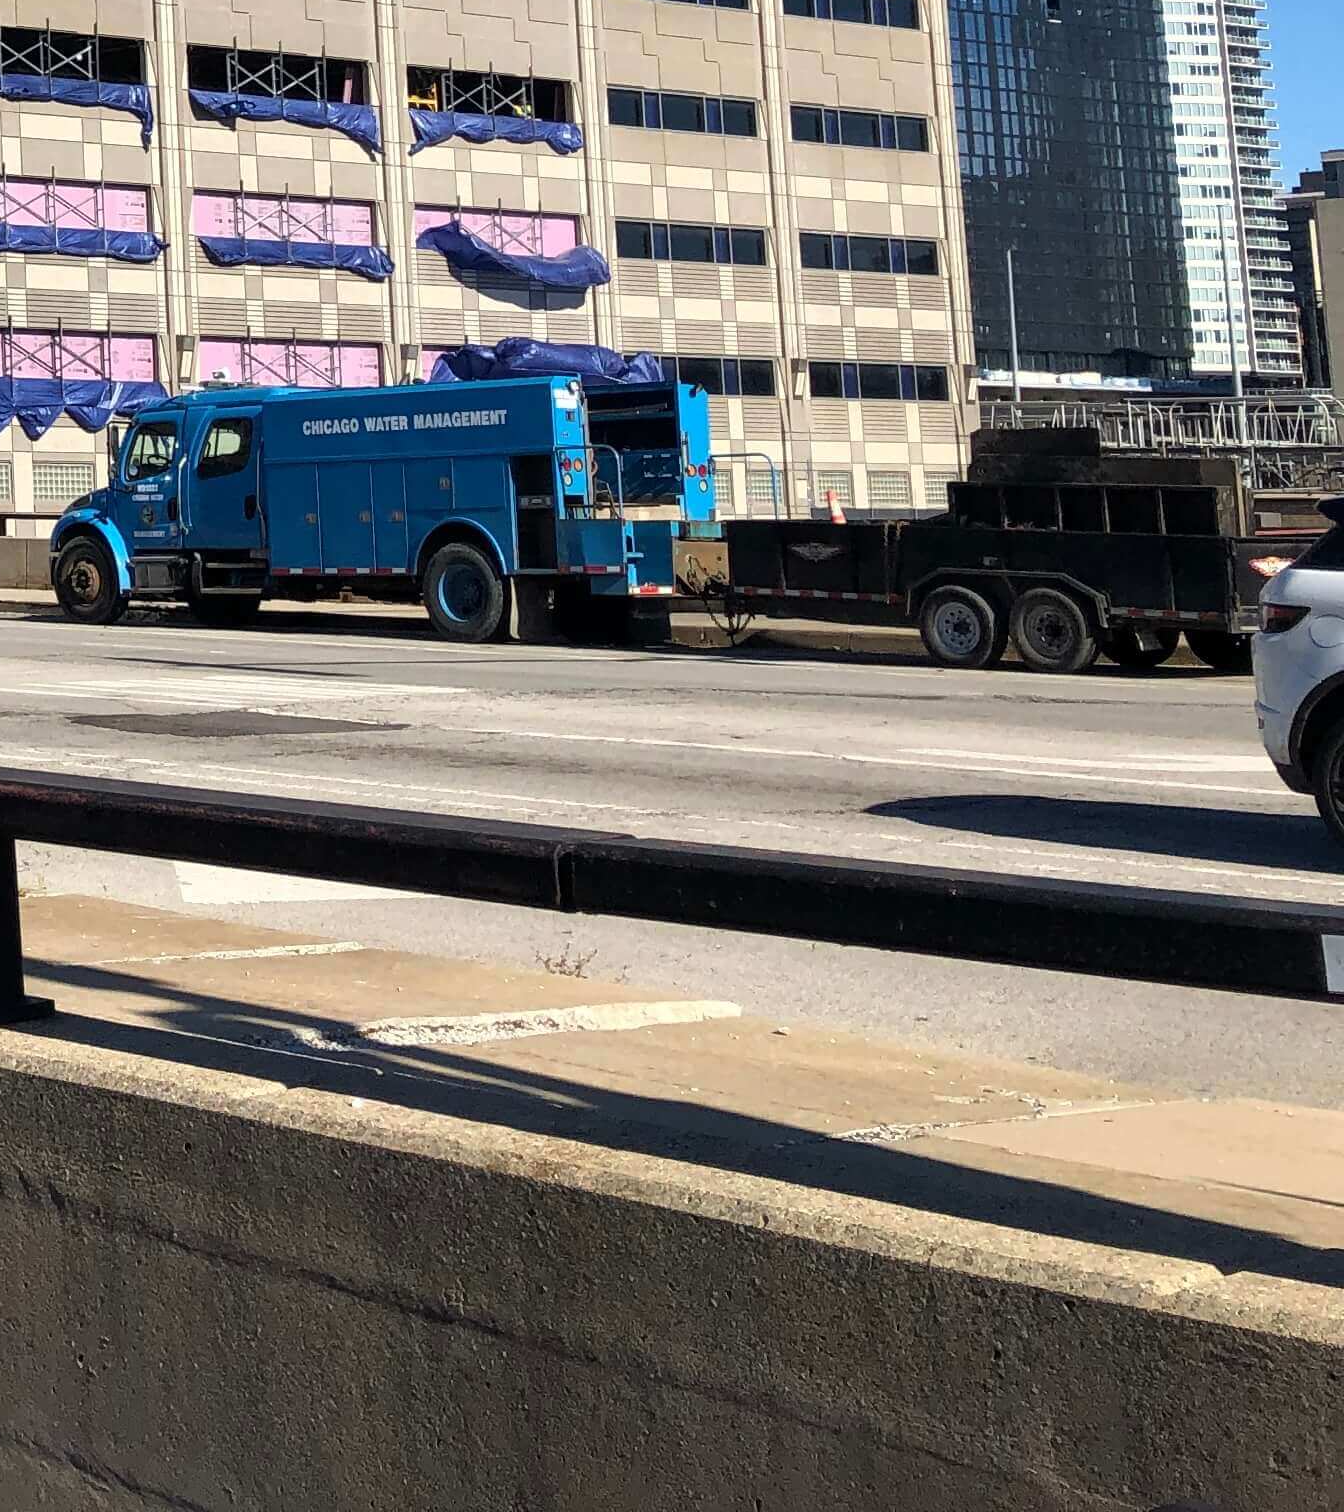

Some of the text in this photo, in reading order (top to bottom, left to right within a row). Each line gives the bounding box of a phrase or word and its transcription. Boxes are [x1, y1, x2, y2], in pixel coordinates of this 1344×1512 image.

[302, 409, 508, 436] CHICAGO WATER MANAGEMENT
